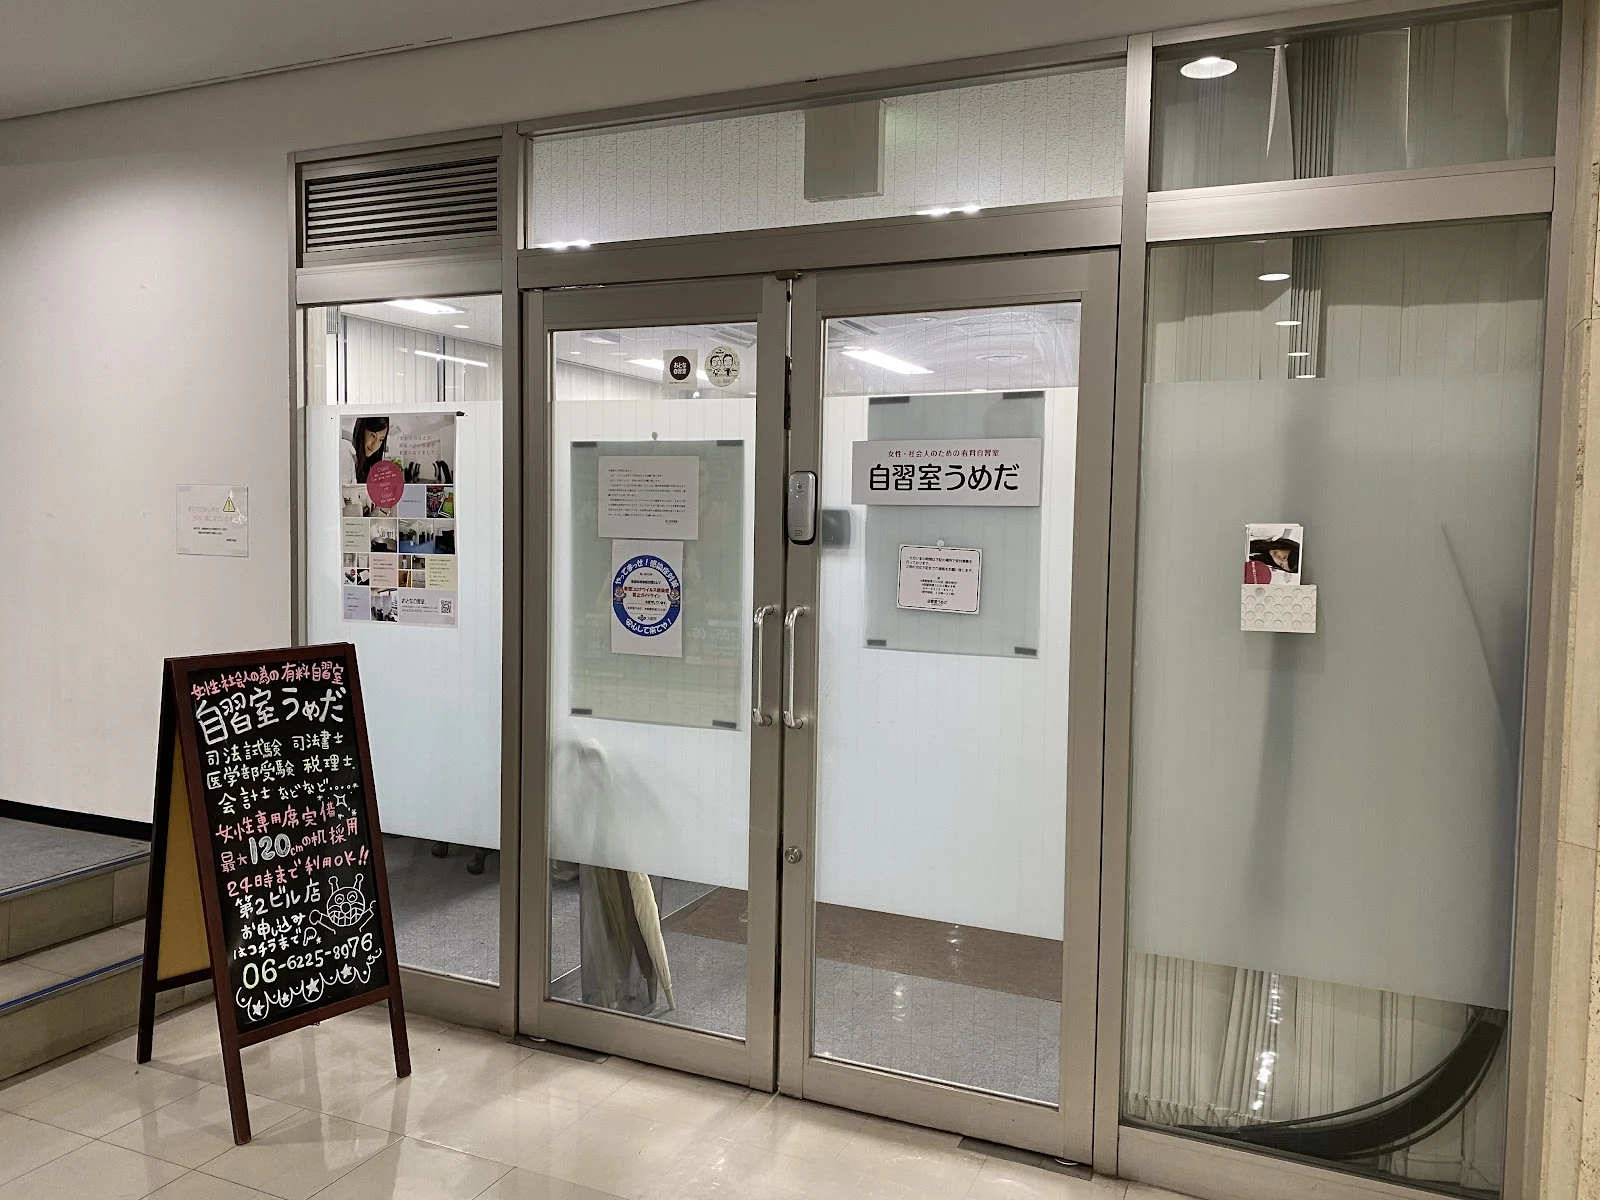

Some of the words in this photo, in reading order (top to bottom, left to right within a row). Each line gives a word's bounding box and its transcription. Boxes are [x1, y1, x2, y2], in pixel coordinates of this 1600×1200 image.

[887, 449, 1000, 458] 女性・社会人のための有料自習室
[869, 463, 1020, 491] 自習室うめだ
[195, 686, 347, 746] 自習室うめだ
[205, 738, 283, 766] 司法試験
[292, 729, 344, 751] 司法書士
[206, 759, 296, 790] 医学部受験
[303, 754, 353, 774] 税理士
[218, 786, 271, 815] 会計士
[234, 878, 321, 919] 第2ビル店
[233, 927, 302, 960] はコチラまで
[240, 912, 306, 941] お申し込み
[242, 932, 373, 989] 06-6225-8976
